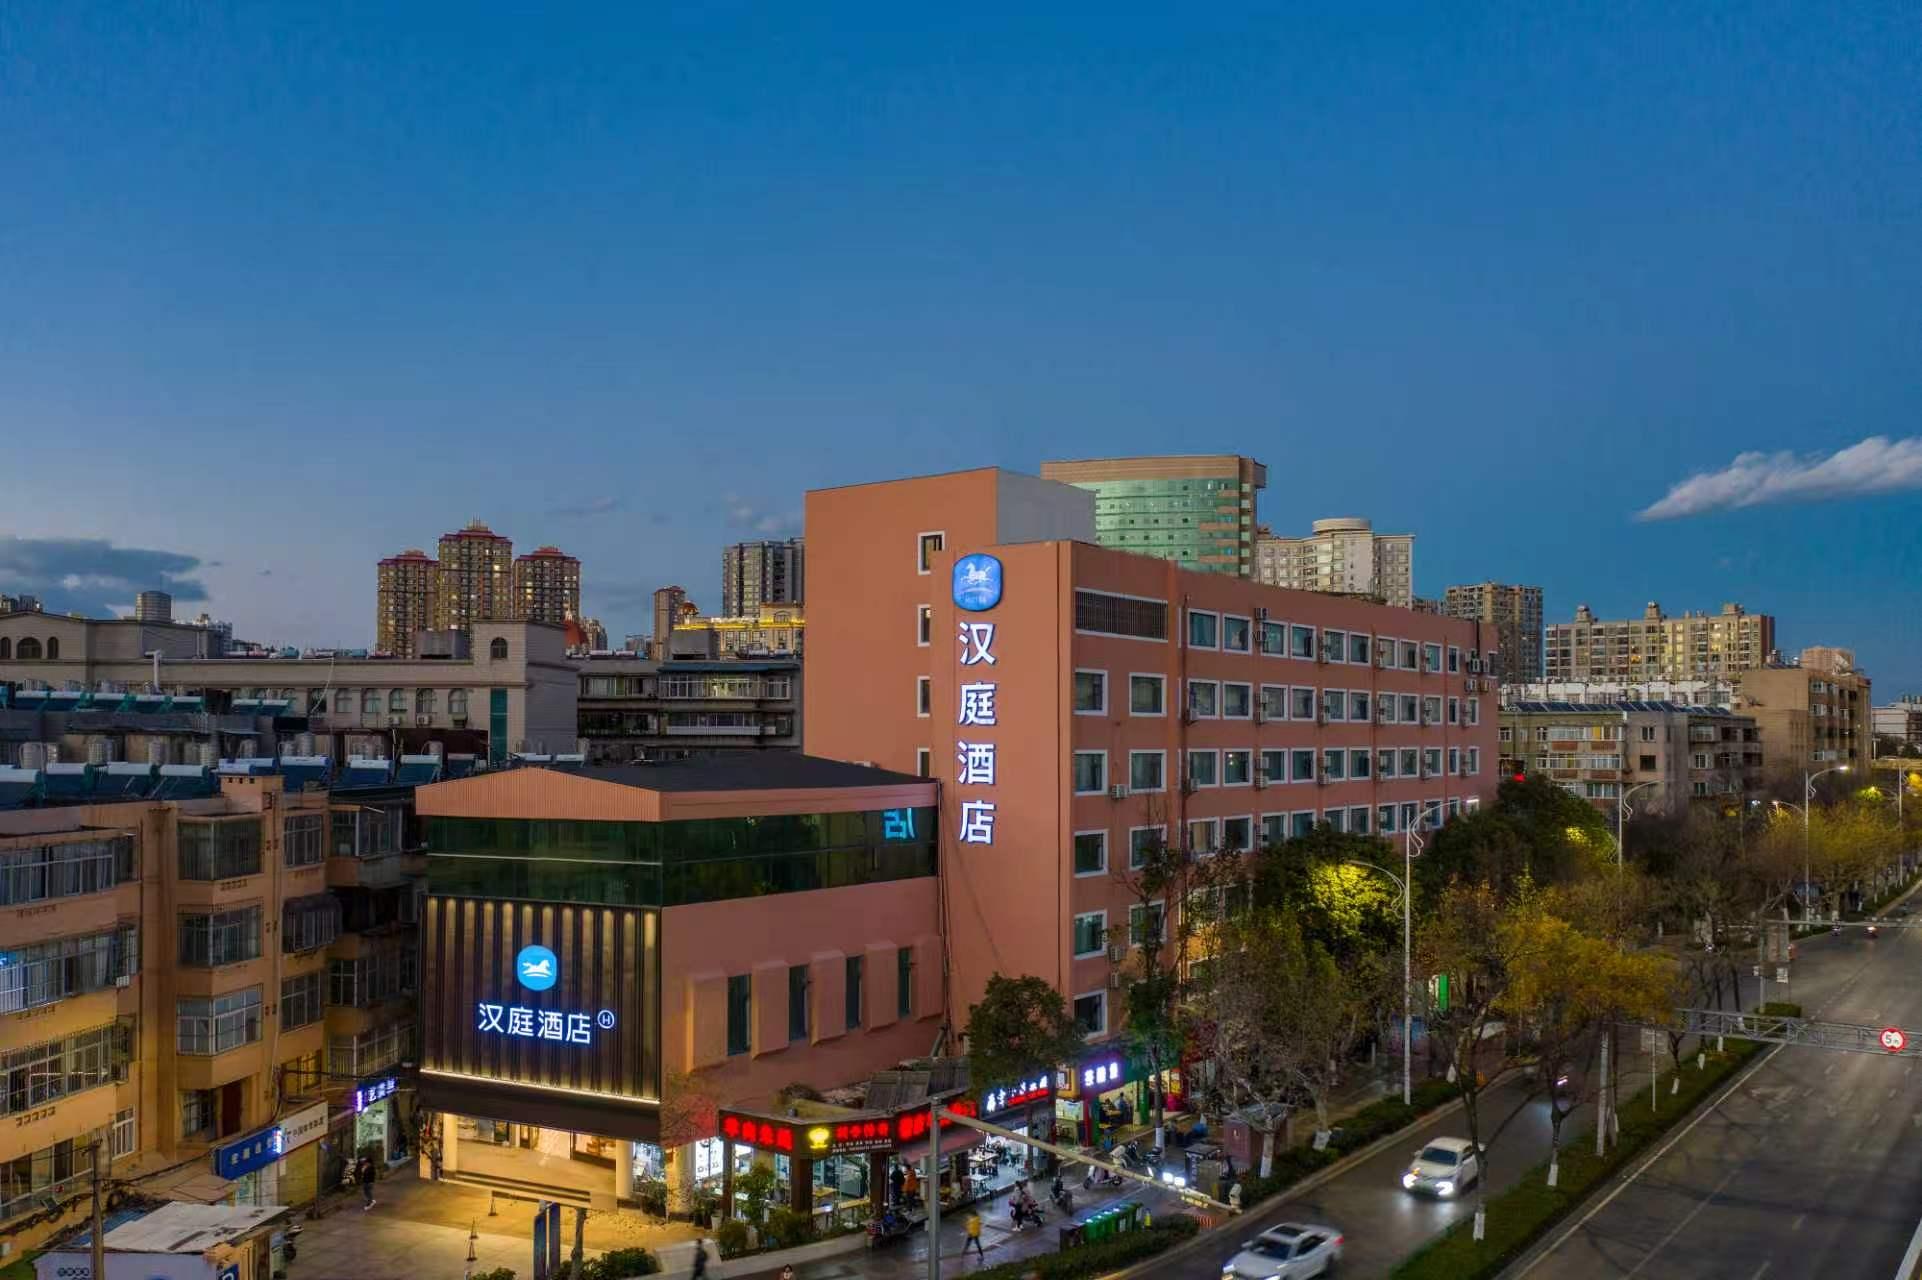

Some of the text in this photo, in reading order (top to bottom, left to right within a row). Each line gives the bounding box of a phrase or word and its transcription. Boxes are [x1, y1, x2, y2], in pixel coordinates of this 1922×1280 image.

[958, 621, 997, 845] 汉庭酒店
[477, 1002, 591, 1044] 汉庭酒店
